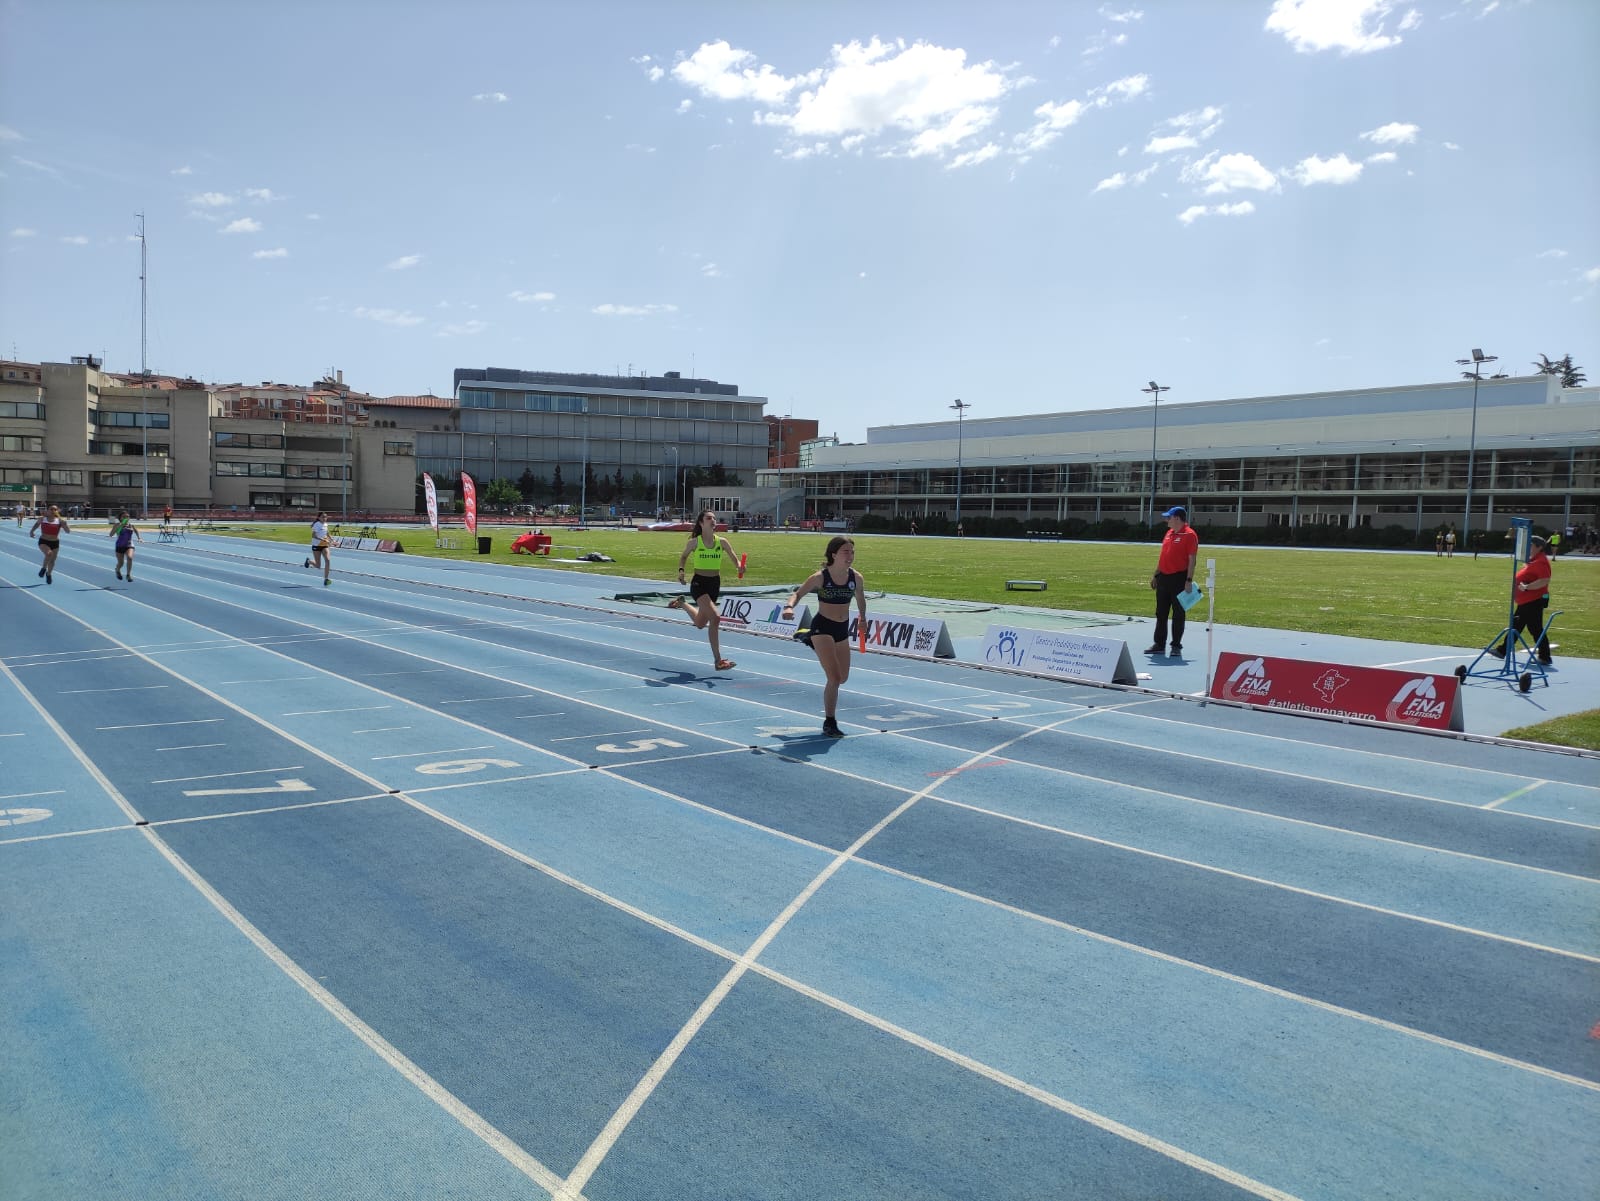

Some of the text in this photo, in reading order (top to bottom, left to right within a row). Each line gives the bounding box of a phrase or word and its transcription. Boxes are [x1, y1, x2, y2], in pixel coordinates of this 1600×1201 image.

[720, 599, 751, 624] IMQ
[986, 636, 1024, 666] CPM
[1236, 688, 1268, 696] ATLETISMO
[1240, 677, 1272, 692] FNA
[1268, 698, 1377, 721] #atletismonavarro
[1407, 697, 1445, 714] FNA
[865, 710, 940, 722] 3
[1402, 710, 1442, 720] ATLETISMO
[596, 738, 689, 754] 5
[415, 758, 523, 775] 6
[183, 778, 316, 797] 7
